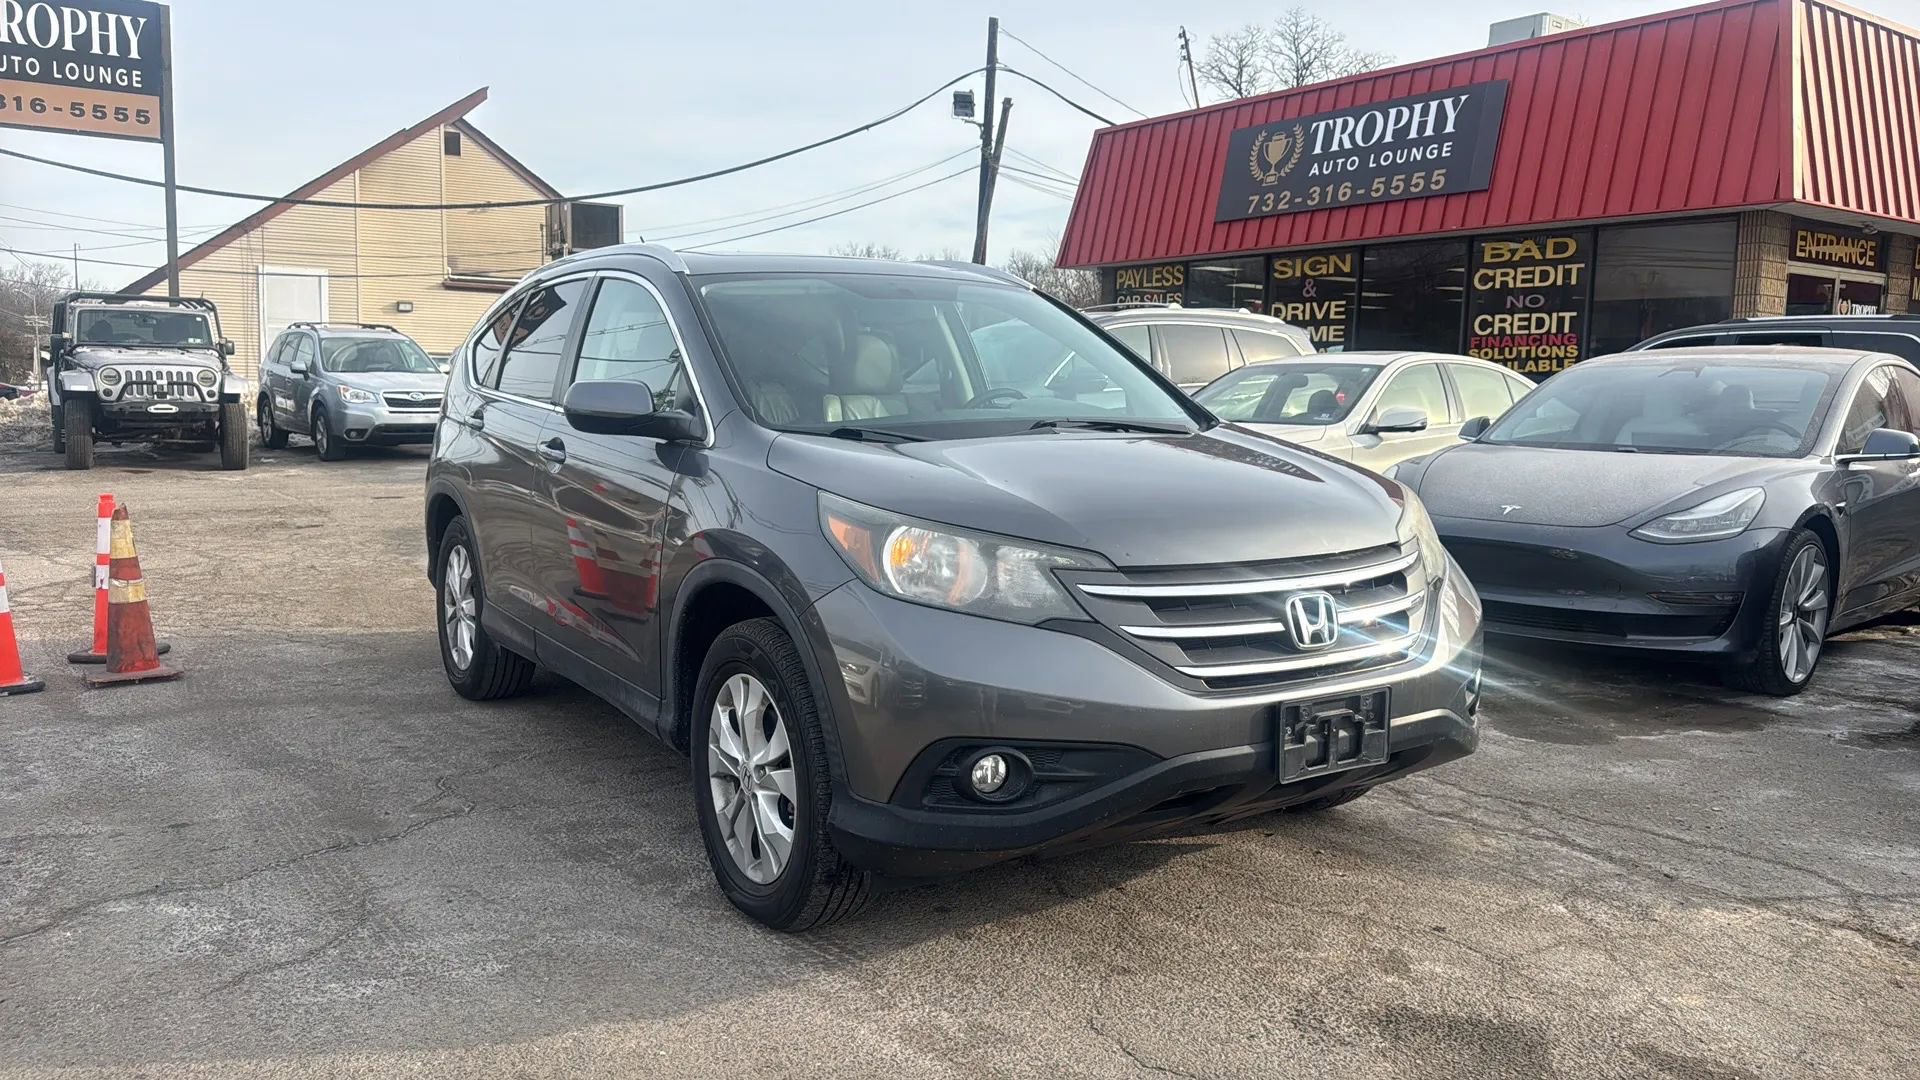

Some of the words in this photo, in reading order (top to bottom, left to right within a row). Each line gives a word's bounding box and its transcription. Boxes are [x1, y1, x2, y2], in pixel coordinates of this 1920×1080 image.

[53, 61, 142, 88] LOUNGE
[1310, 94, 1470, 155] TROPHY
[1309, 156, 1359, 177] AUTO
[1369, 142, 1453, 168] LOUNGE
[1247, 168, 1447, 214] 732-316-5555
[1483, 237, 1577, 263] BAD
[1795, 230, 1876, 267] ENTRANCE
[1116, 265, 1184, 289] PAYLESS
[1273, 255, 1351, 279] SIGN
[1473, 263, 1585, 290] CREDIT
[1302, 278, 1317, 298] &
[1117, 295, 1140, 308] CAR
[1144, 293, 1182, 305] SALES
[1271, 301, 1346, 320] DRIVE
[1505, 294, 1545, 309] NO
[1852, 303, 1878, 315] TROPHY
[1473, 311, 1577, 335] CREDIT
[1468, 345, 1579, 360] SOLUTIONS
[1470, 333, 1577, 348] FINANCING
